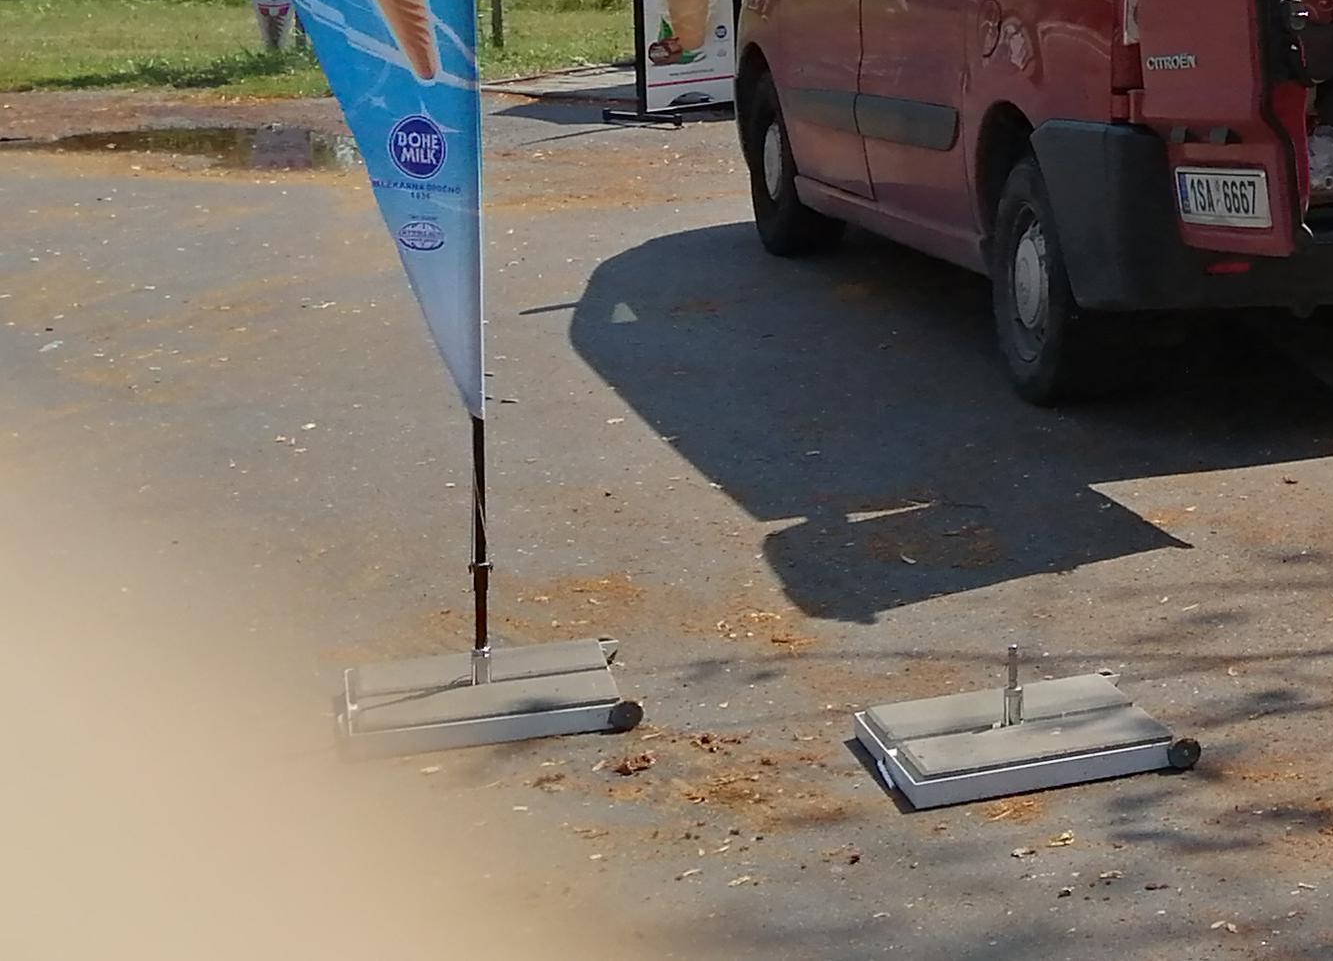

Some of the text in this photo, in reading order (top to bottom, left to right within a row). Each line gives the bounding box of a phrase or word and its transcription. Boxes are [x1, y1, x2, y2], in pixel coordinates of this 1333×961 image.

[400, 148, 438, 165] MILK
[1190, 178, 1256, 215] 1SA 6667
